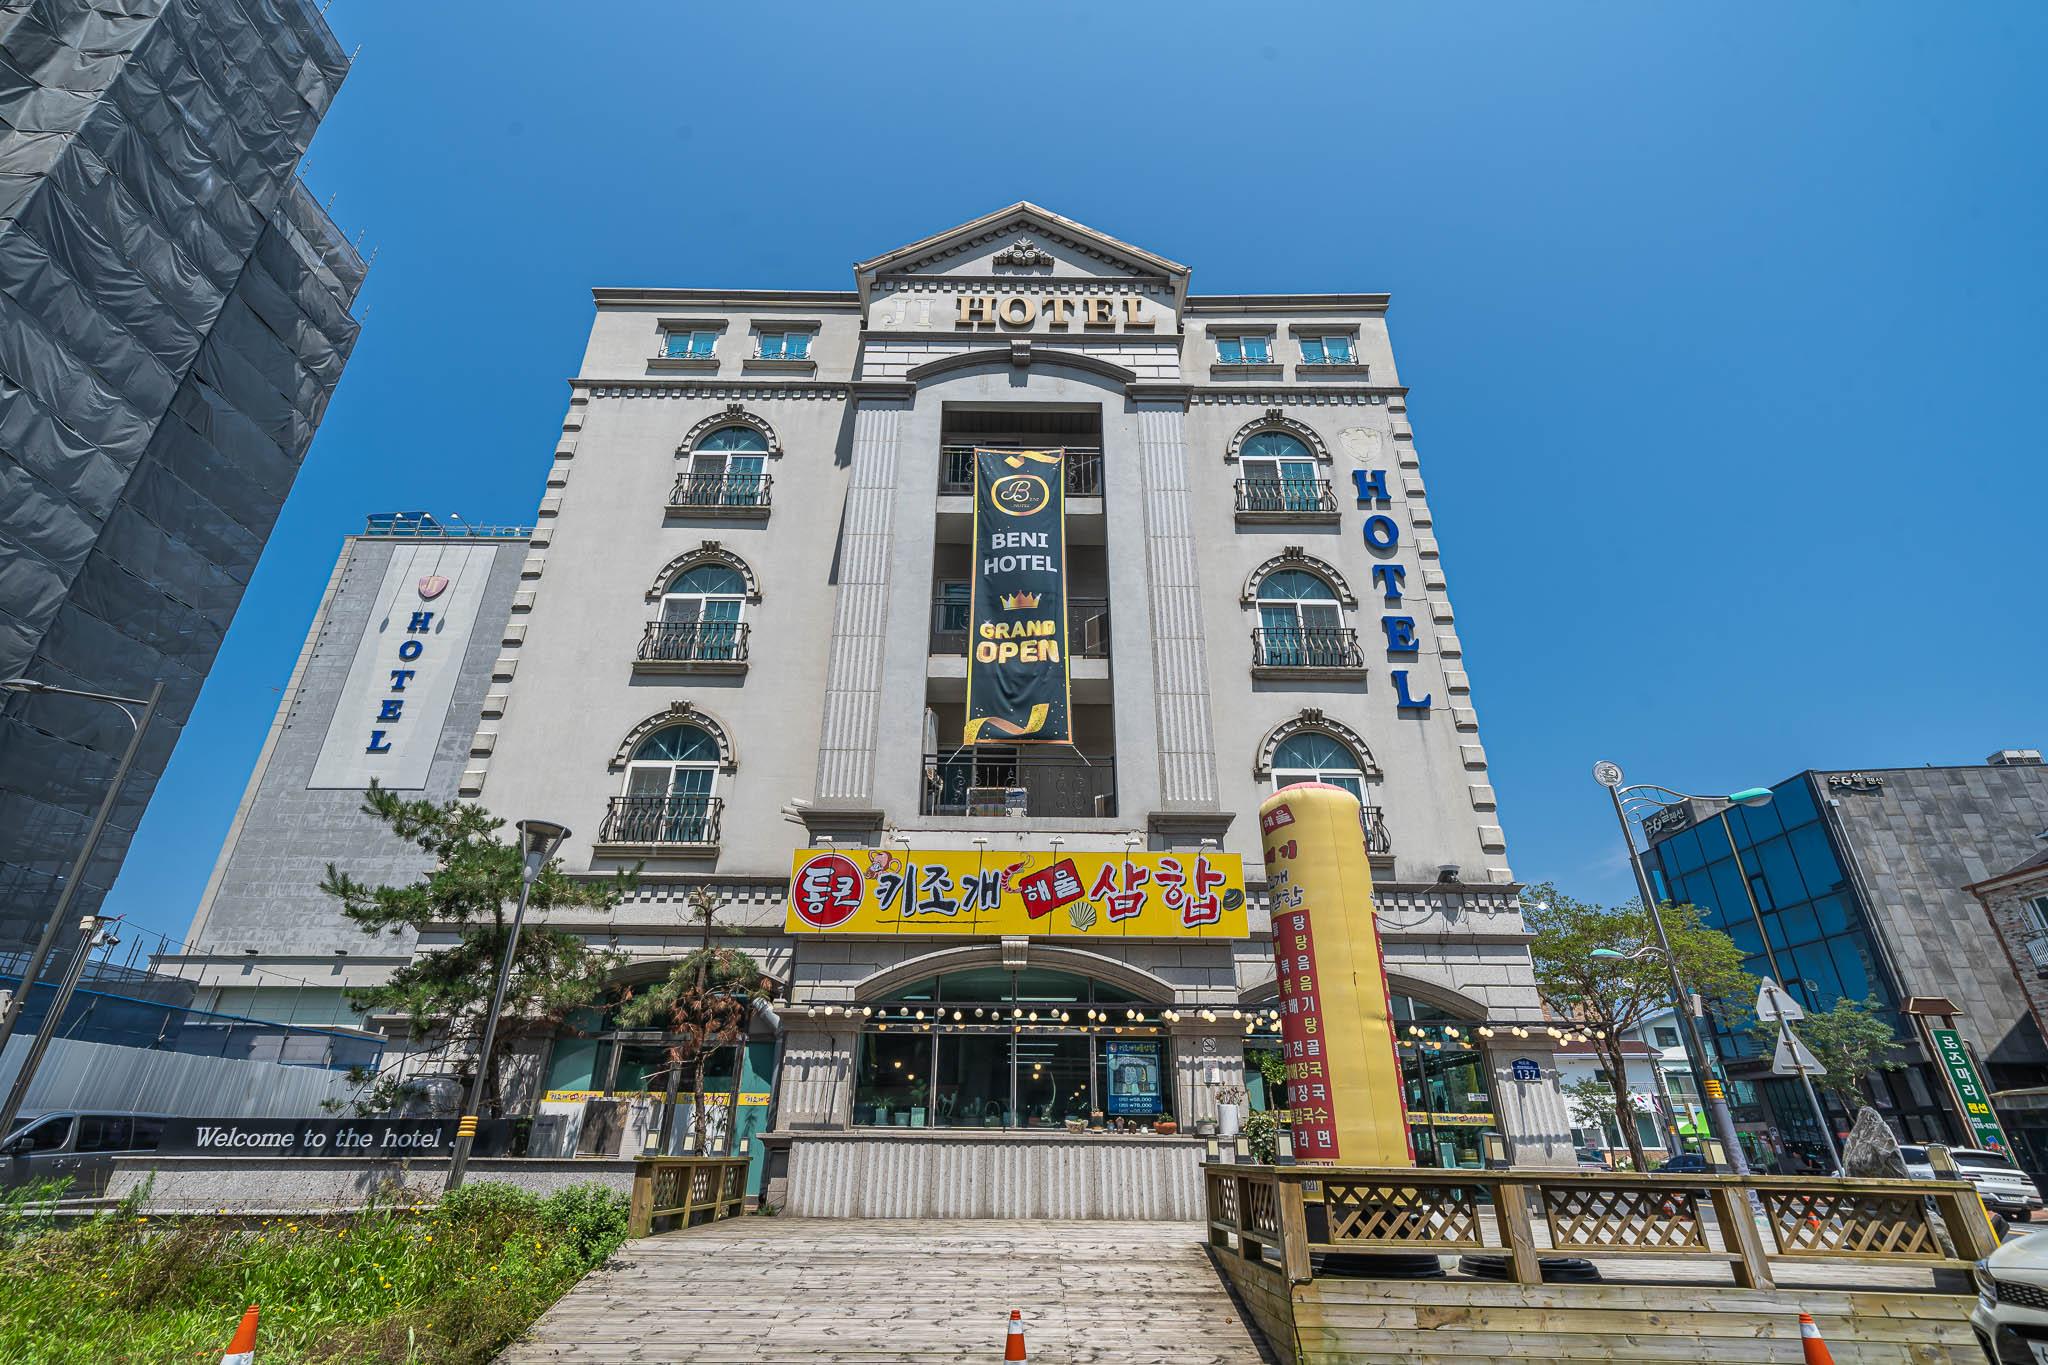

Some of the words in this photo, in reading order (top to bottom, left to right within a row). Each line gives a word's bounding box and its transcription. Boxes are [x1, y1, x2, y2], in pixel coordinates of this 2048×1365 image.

[955, 296, 1156, 324] HOTEL
[991, 532, 1049, 550] BENI
[983, 555, 1058, 575] HOTEL
[1352, 469, 1432, 709] HOTEL
[979, 619, 1056, 640] GRAND
[976, 638, 1060, 664] OPEN
[365, 611, 434, 755] HOTEL
[802, 867, 860, 914] 통큰
[874, 862, 1001, 917] 키조개
[1024, 869, 1081, 902] 해물
[1087, 855, 1225, 930] 삼합
[1517, 1069, 1536, 1080] 137
[1942, 1035, 1980, 1100] 로즈마리
[1967, 1102, 1989, 1114] 펜션
[194, 1126, 295, 1148] Welcome
[303, 1129, 327, 1148] to
[335, 1127, 373, 1148] the
[380, 1127, 442, 1148] hotel
